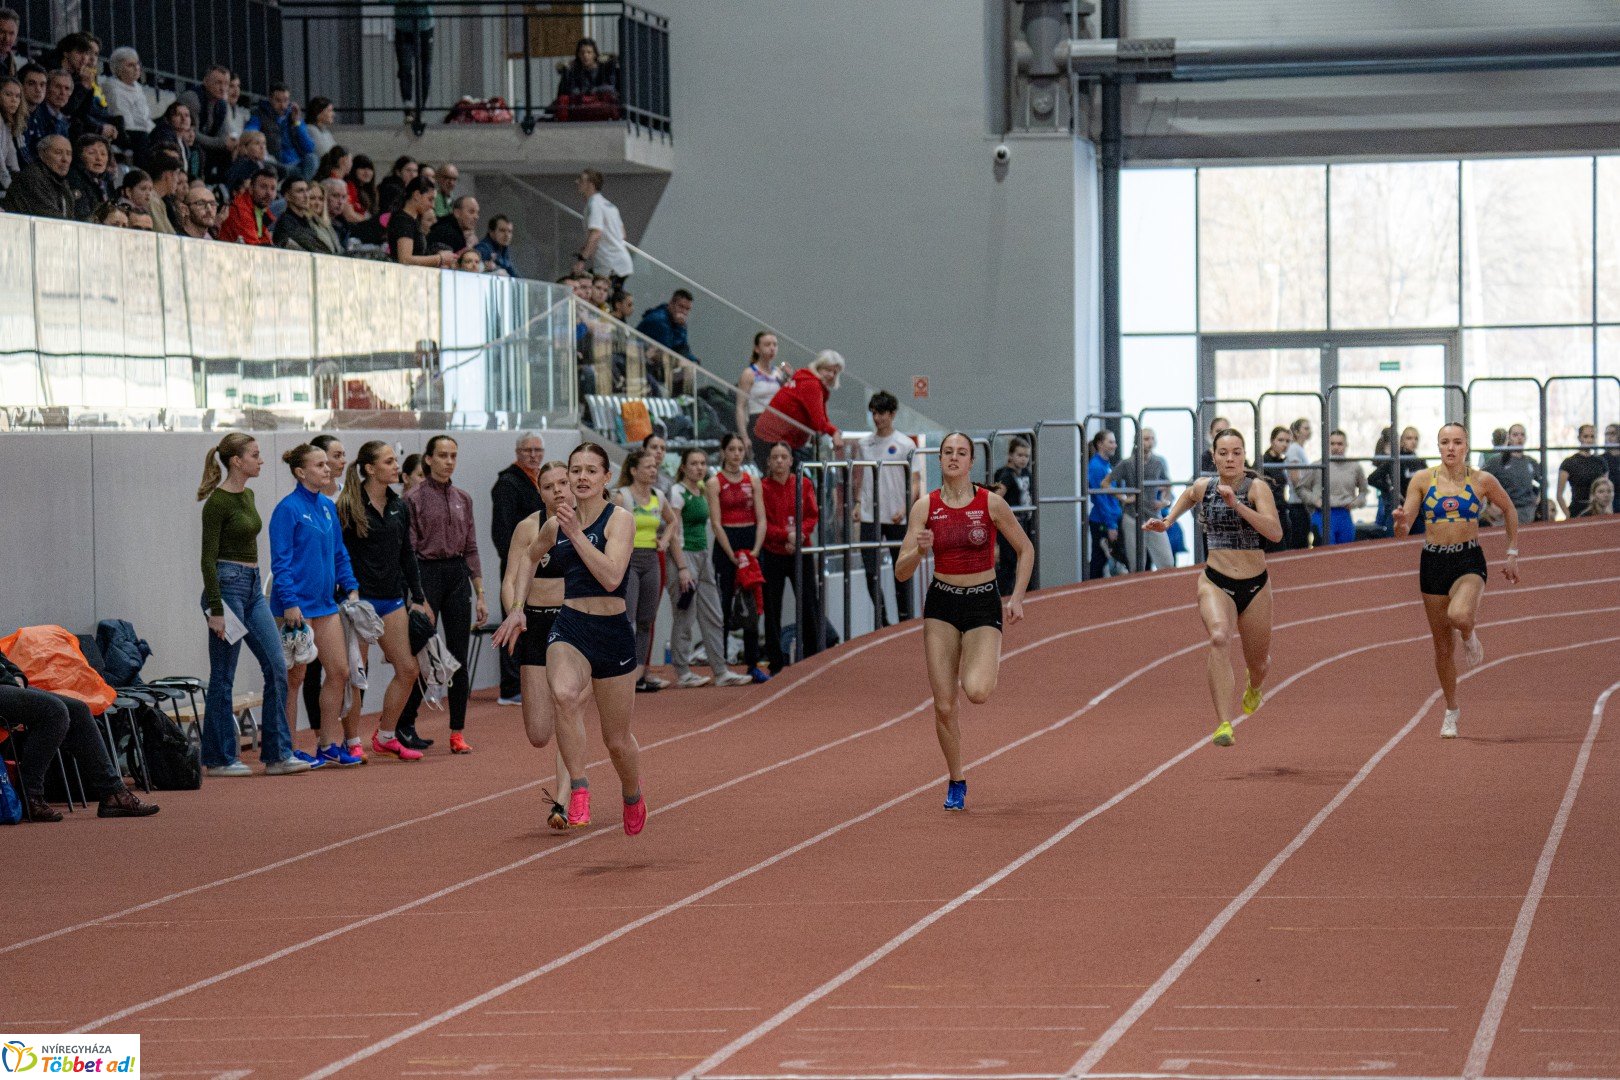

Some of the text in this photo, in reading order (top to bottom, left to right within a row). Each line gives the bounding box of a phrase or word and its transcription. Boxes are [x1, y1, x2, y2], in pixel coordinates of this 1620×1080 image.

[1438, 543, 1463, 553] PRO
[934, 582, 994, 595] NIKE PRO
